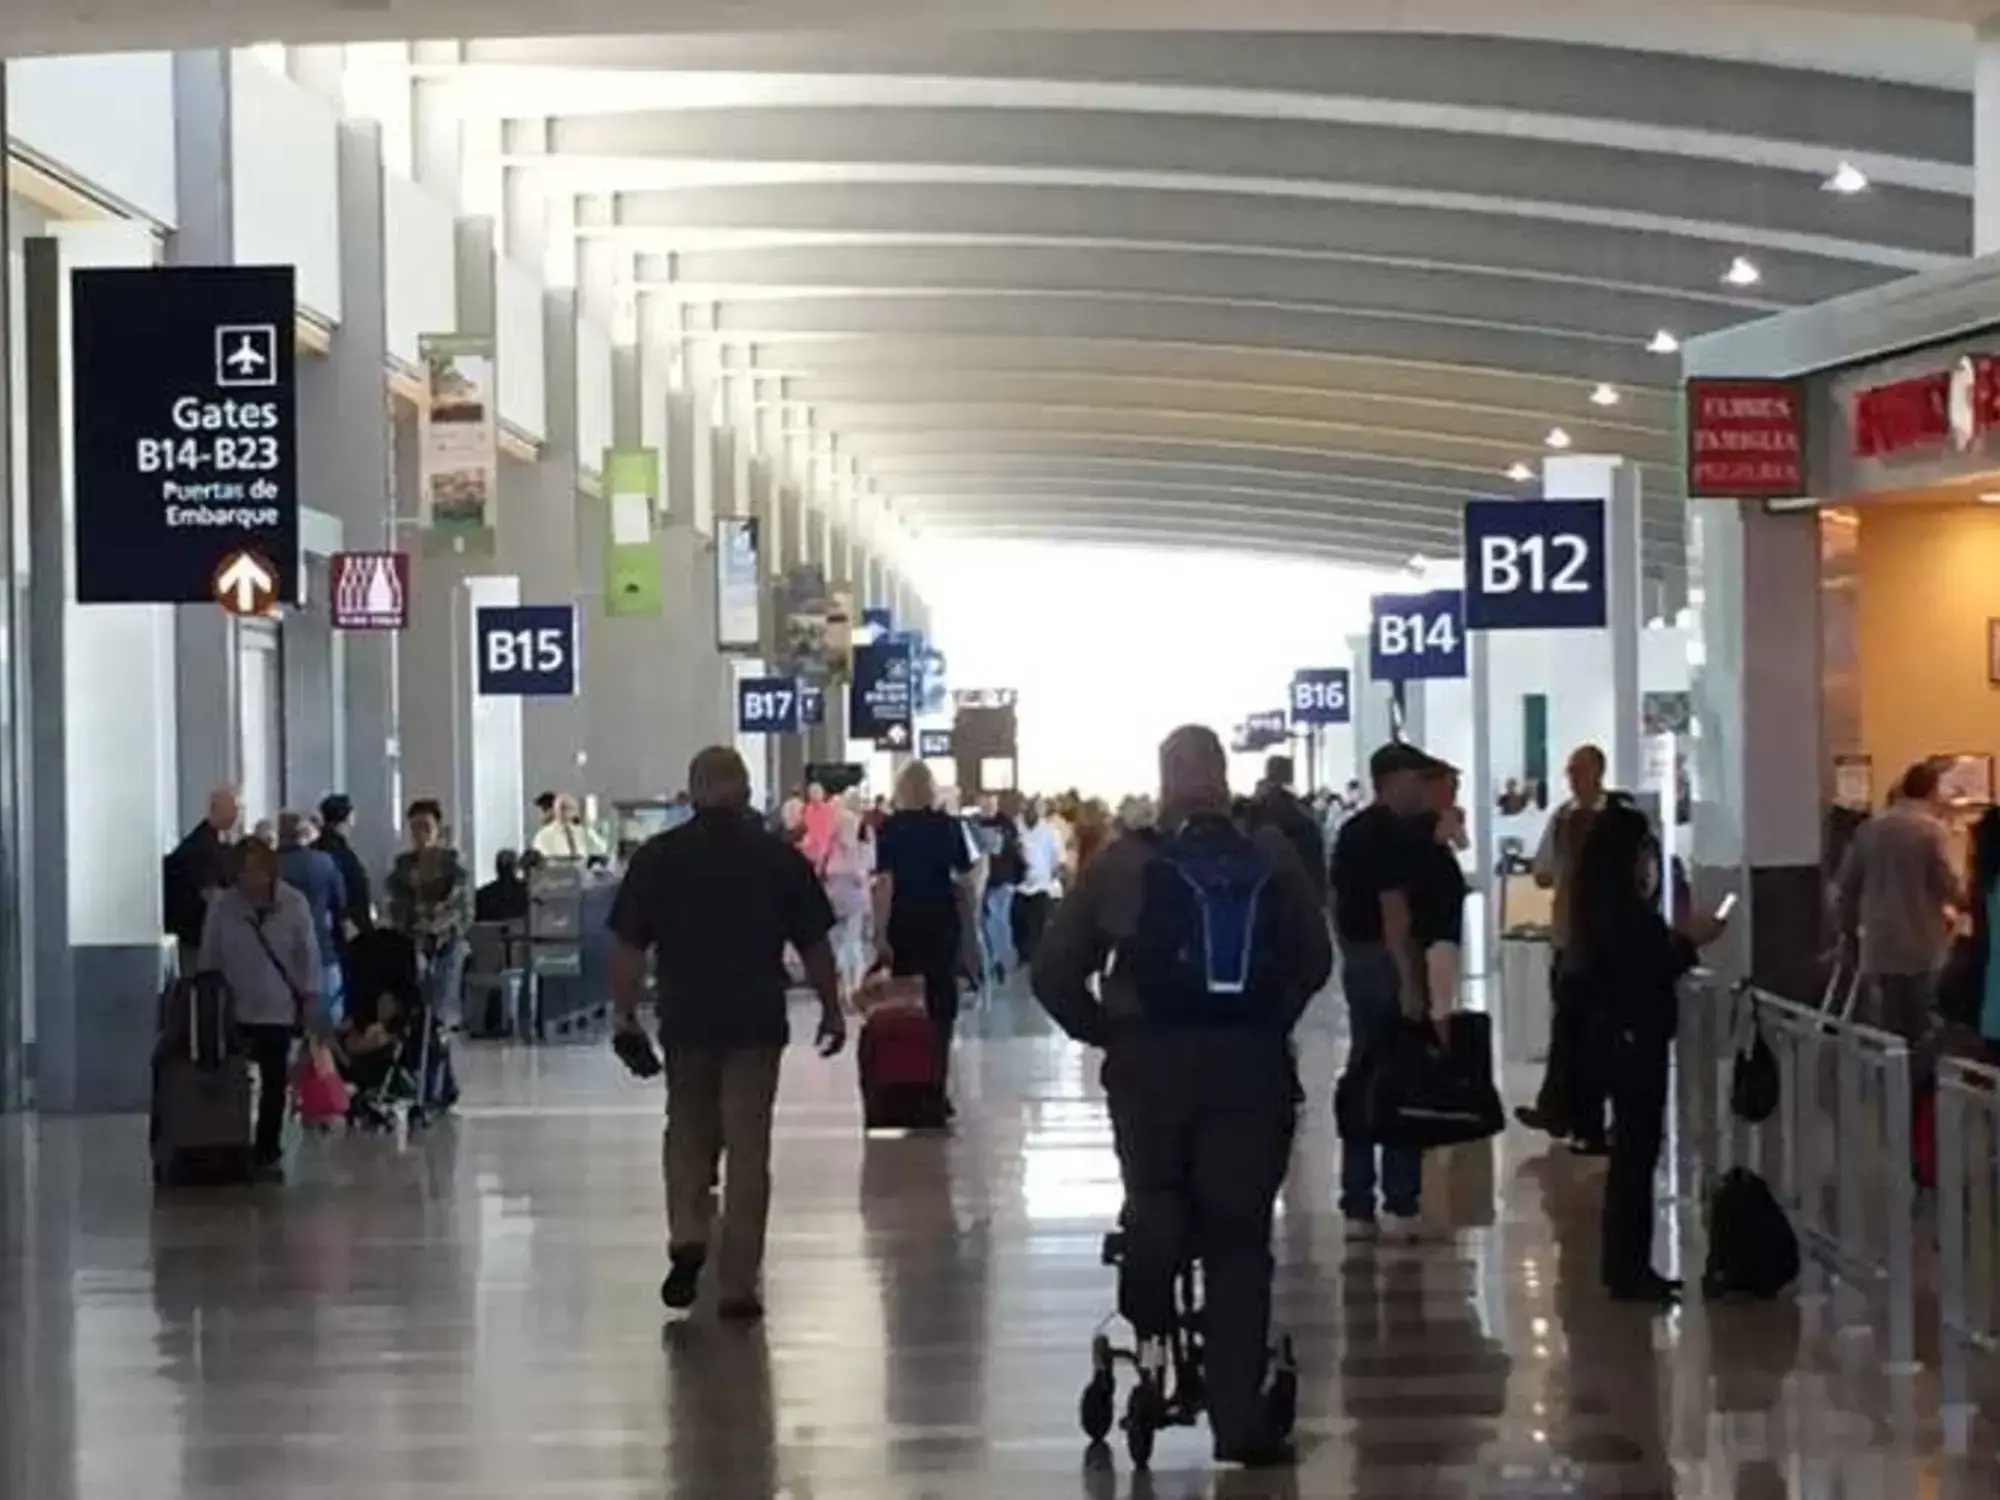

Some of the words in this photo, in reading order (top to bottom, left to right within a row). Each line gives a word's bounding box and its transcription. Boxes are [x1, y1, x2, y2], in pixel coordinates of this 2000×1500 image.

[172, 396, 278, 430] Gates
[137, 435, 279, 472] B14-B23
[163, 481, 244, 501] Puertas
[249, 478, 278, 500] de
[165, 504, 279, 530] Embarque
[1481, 534, 1590, 593] B12
[487, 629, 563, 672] B15
[1378, 613, 1458, 655] B14
[744, 690, 793, 720] B17
[1294, 680, 1345, 709] B16
